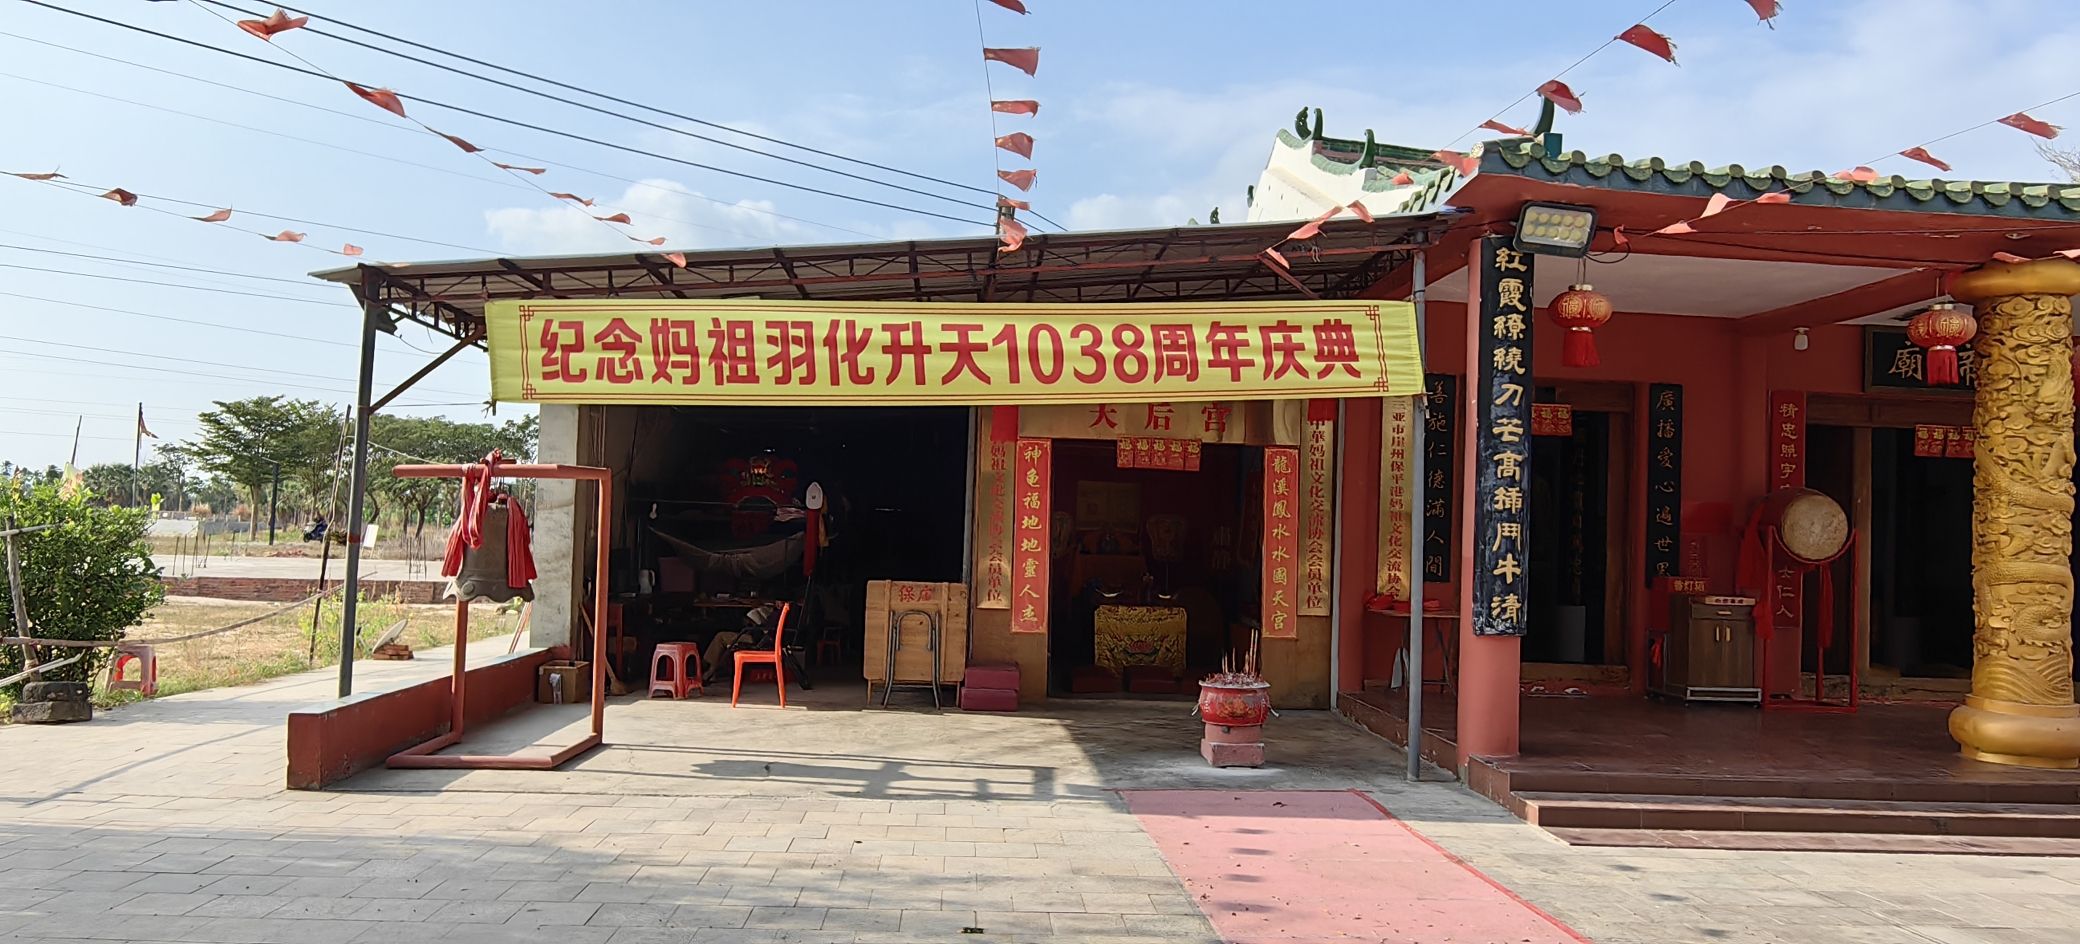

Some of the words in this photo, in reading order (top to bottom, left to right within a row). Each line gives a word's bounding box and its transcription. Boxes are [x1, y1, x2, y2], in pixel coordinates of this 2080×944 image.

[539, 316, 1362, 387] 纪念妈祖羽化升天1038周年庆典
